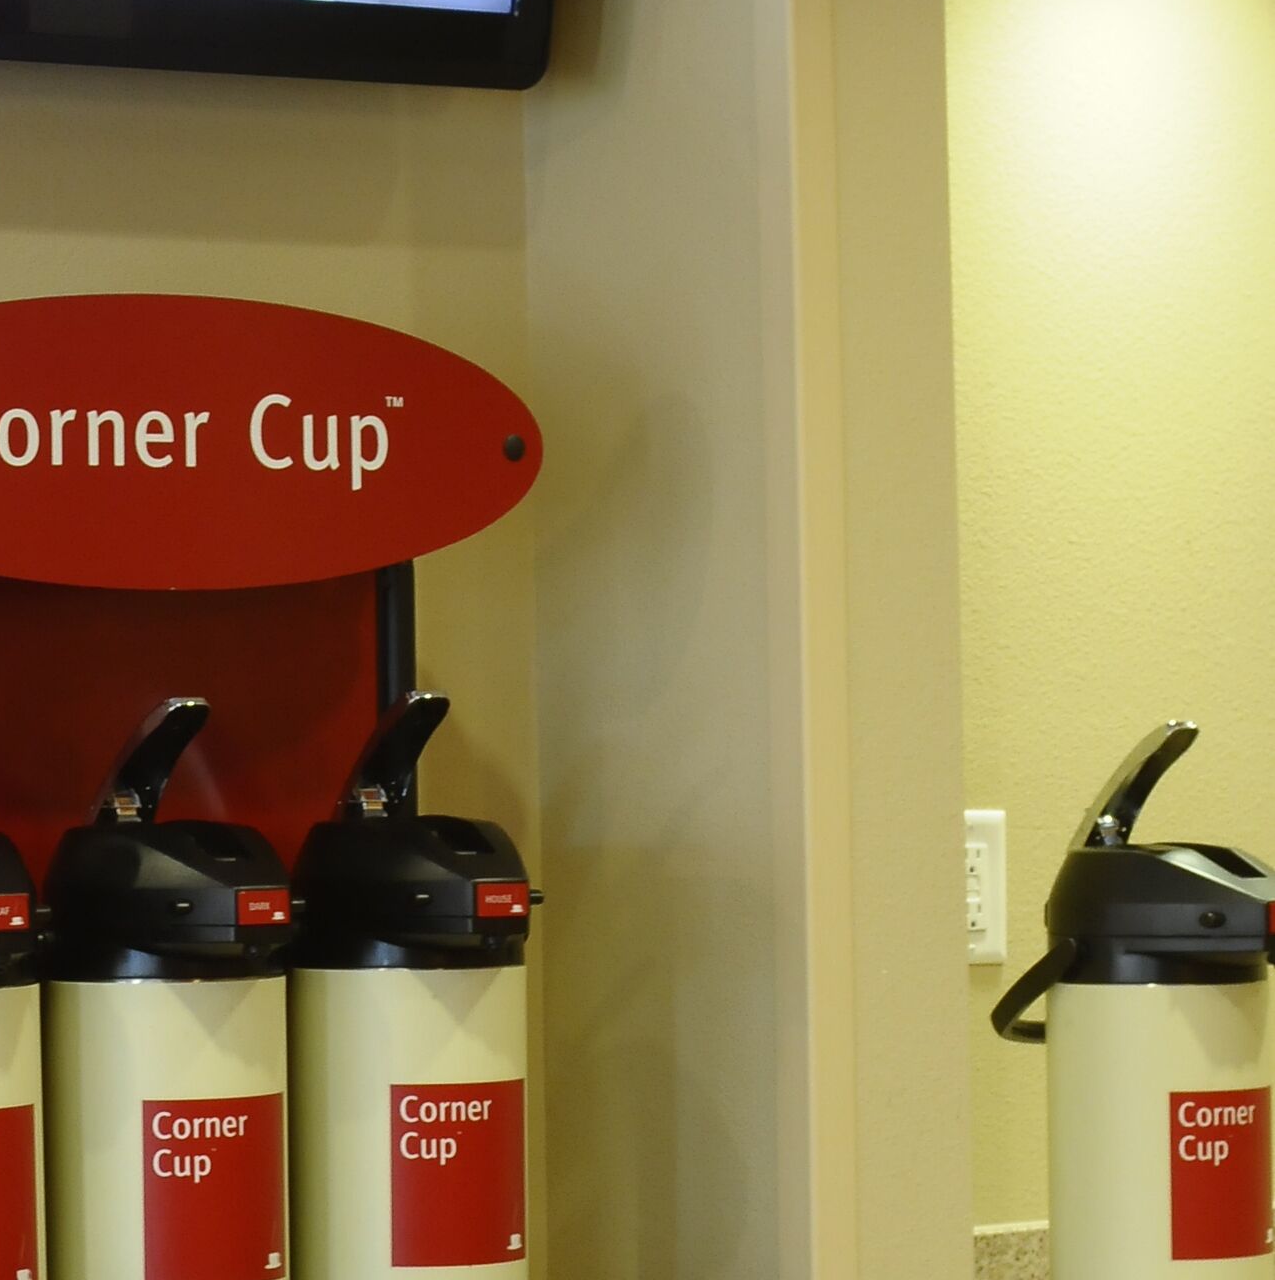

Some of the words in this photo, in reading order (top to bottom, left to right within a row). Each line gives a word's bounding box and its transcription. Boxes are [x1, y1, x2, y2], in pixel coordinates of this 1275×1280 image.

[485, 895, 512, 904] HOUSE
[399, 1095, 492, 1125] Corner
[1177, 1100, 1256, 1127] Corner
[151, 1111, 248, 1142] Corner
[1178, 1135, 1229, 1167] Cup
